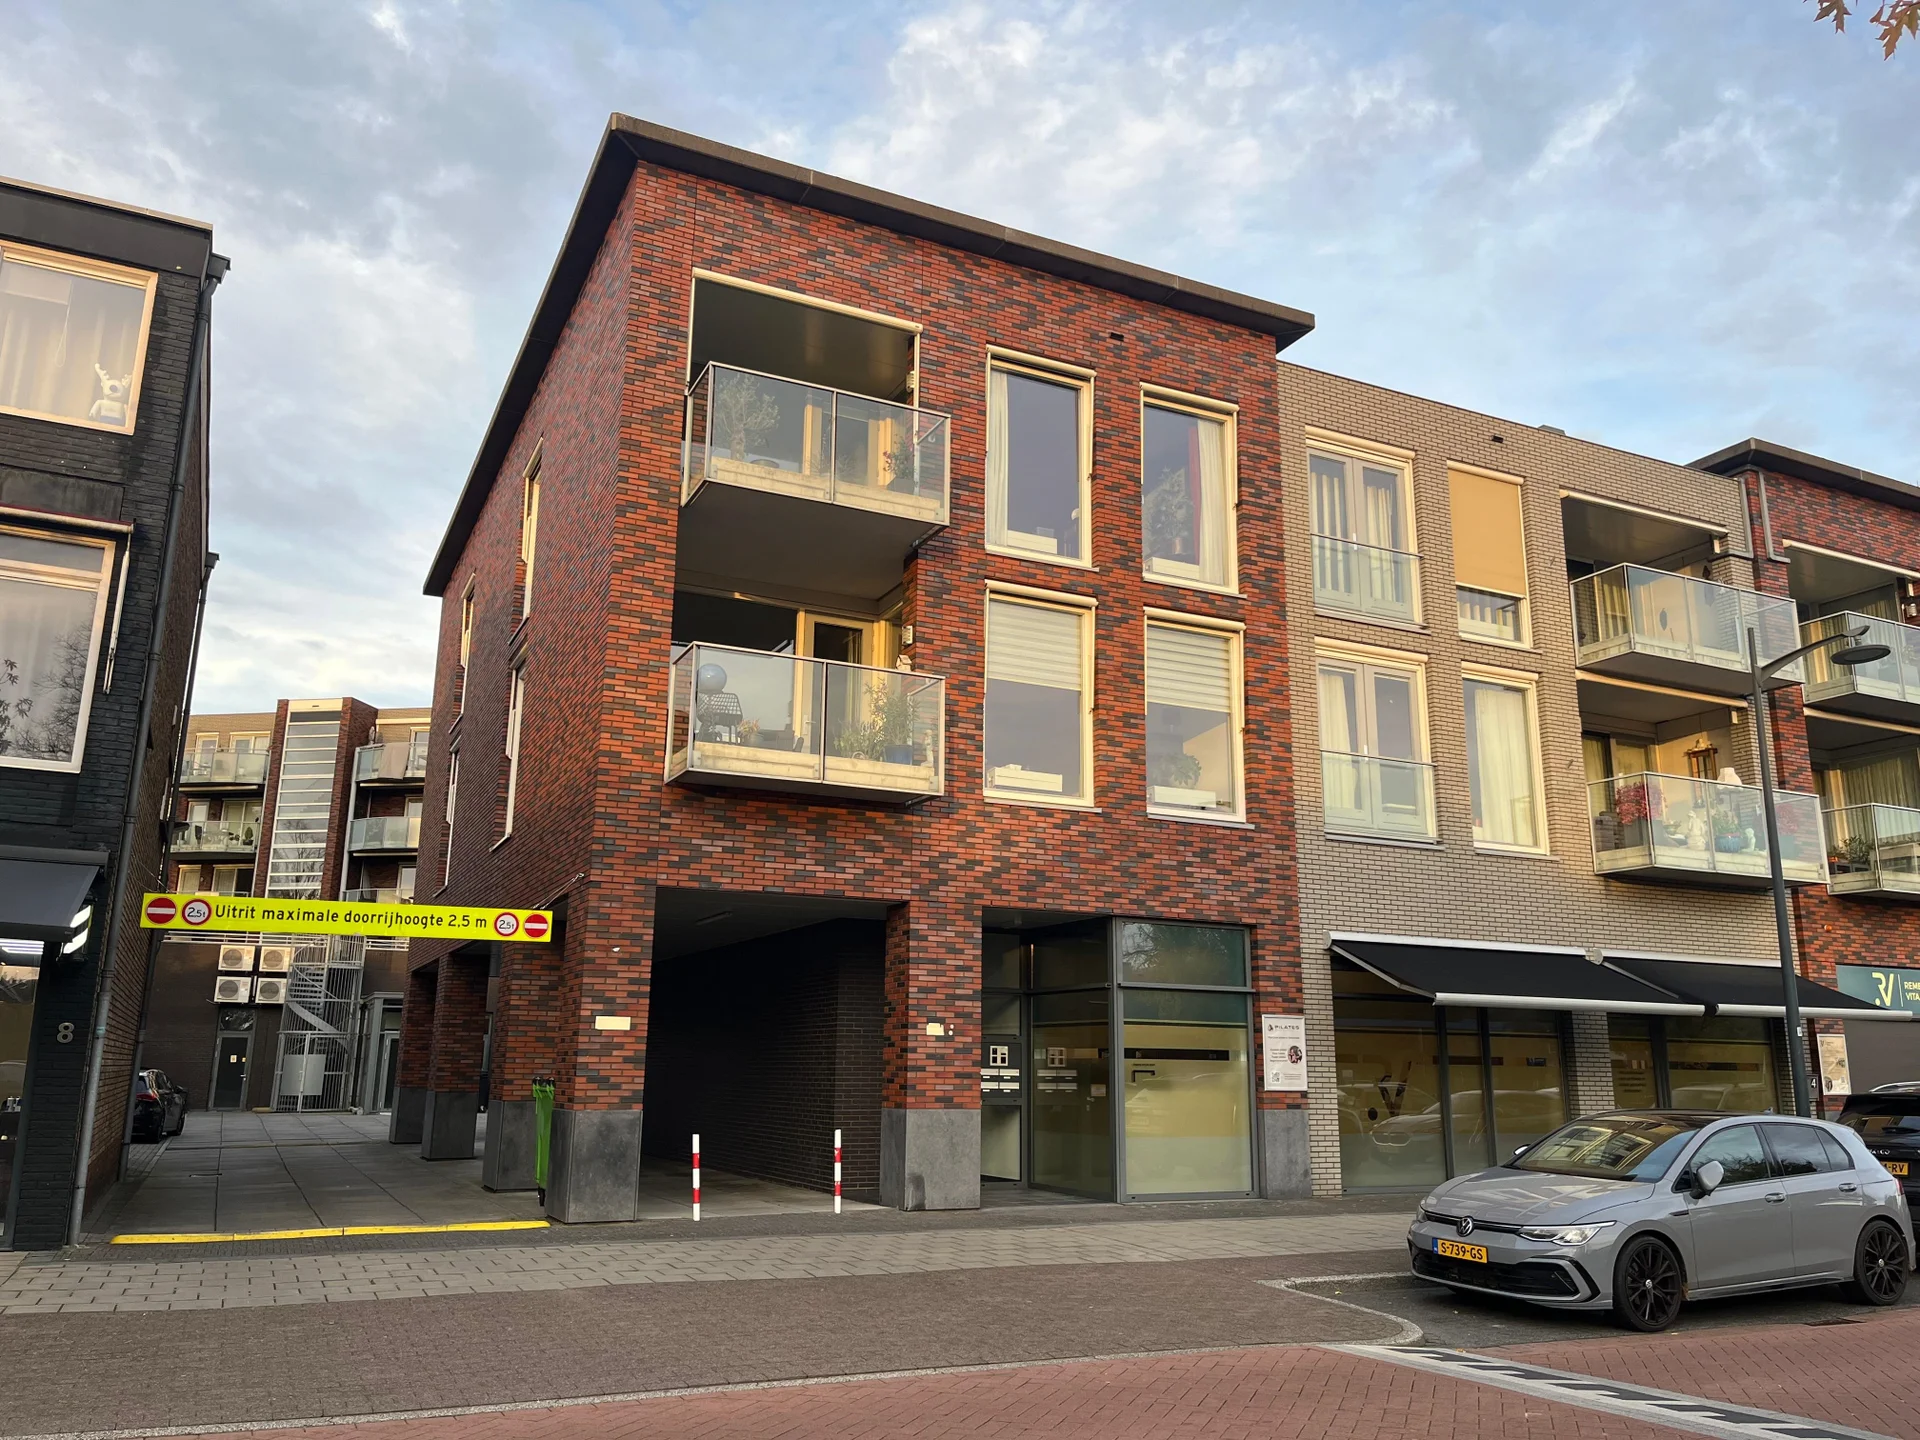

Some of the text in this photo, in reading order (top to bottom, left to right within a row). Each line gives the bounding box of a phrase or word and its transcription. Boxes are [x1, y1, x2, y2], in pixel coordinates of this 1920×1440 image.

[215, 904, 256, 919] Uitrit
[262, 908, 339, 922] maximale
[344, 910, 444, 929] doorrijhoogte
[475, 918, 487, 928] m
[56, 1022, 75, 1044] 8
[1440, 1241, 1483, 1261] S-739-GS
